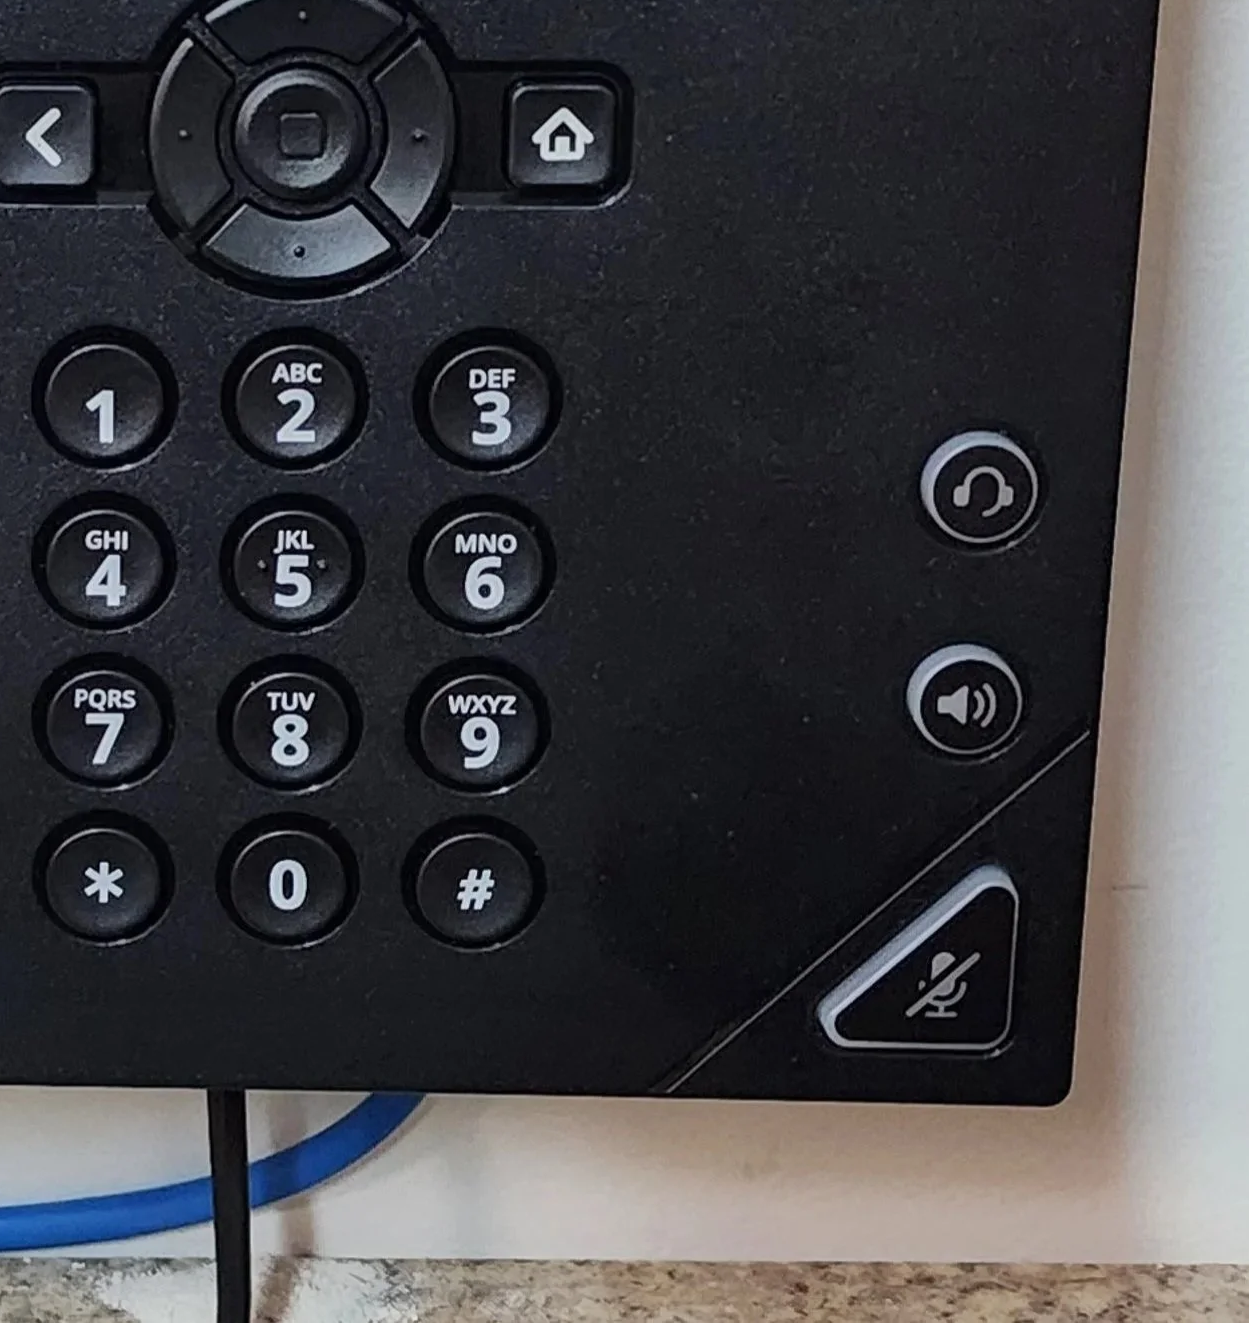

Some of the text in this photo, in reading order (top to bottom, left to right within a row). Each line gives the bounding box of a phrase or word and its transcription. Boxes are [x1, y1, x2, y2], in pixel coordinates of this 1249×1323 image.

[271, 362, 323, 384] ABC
[468, 368, 516, 390] DEF
[85, 389, 114, 445] 1
[276, 388, 316, 445] 2
[471, 390, 512, 446] 3
[84, 529, 129, 551] GHI
[273, 529, 315, 553] JKL
[455, 533, 518, 554] MNO
[85, 554, 127, 607] 4
[274, 554, 312, 608] 5
[464, 555, 505, 611] 6
[74, 688, 137, 712] PQRS
[266, 691, 316, 712] TUV
[448, 694, 517, 715] WXYZ
[85, 712, 125, 765] 7
[271, 713, 310, 767] 8
[460, 716, 500, 769] 9
[269, 859, 308, 911] 0
[456, 868, 495, 911] #
